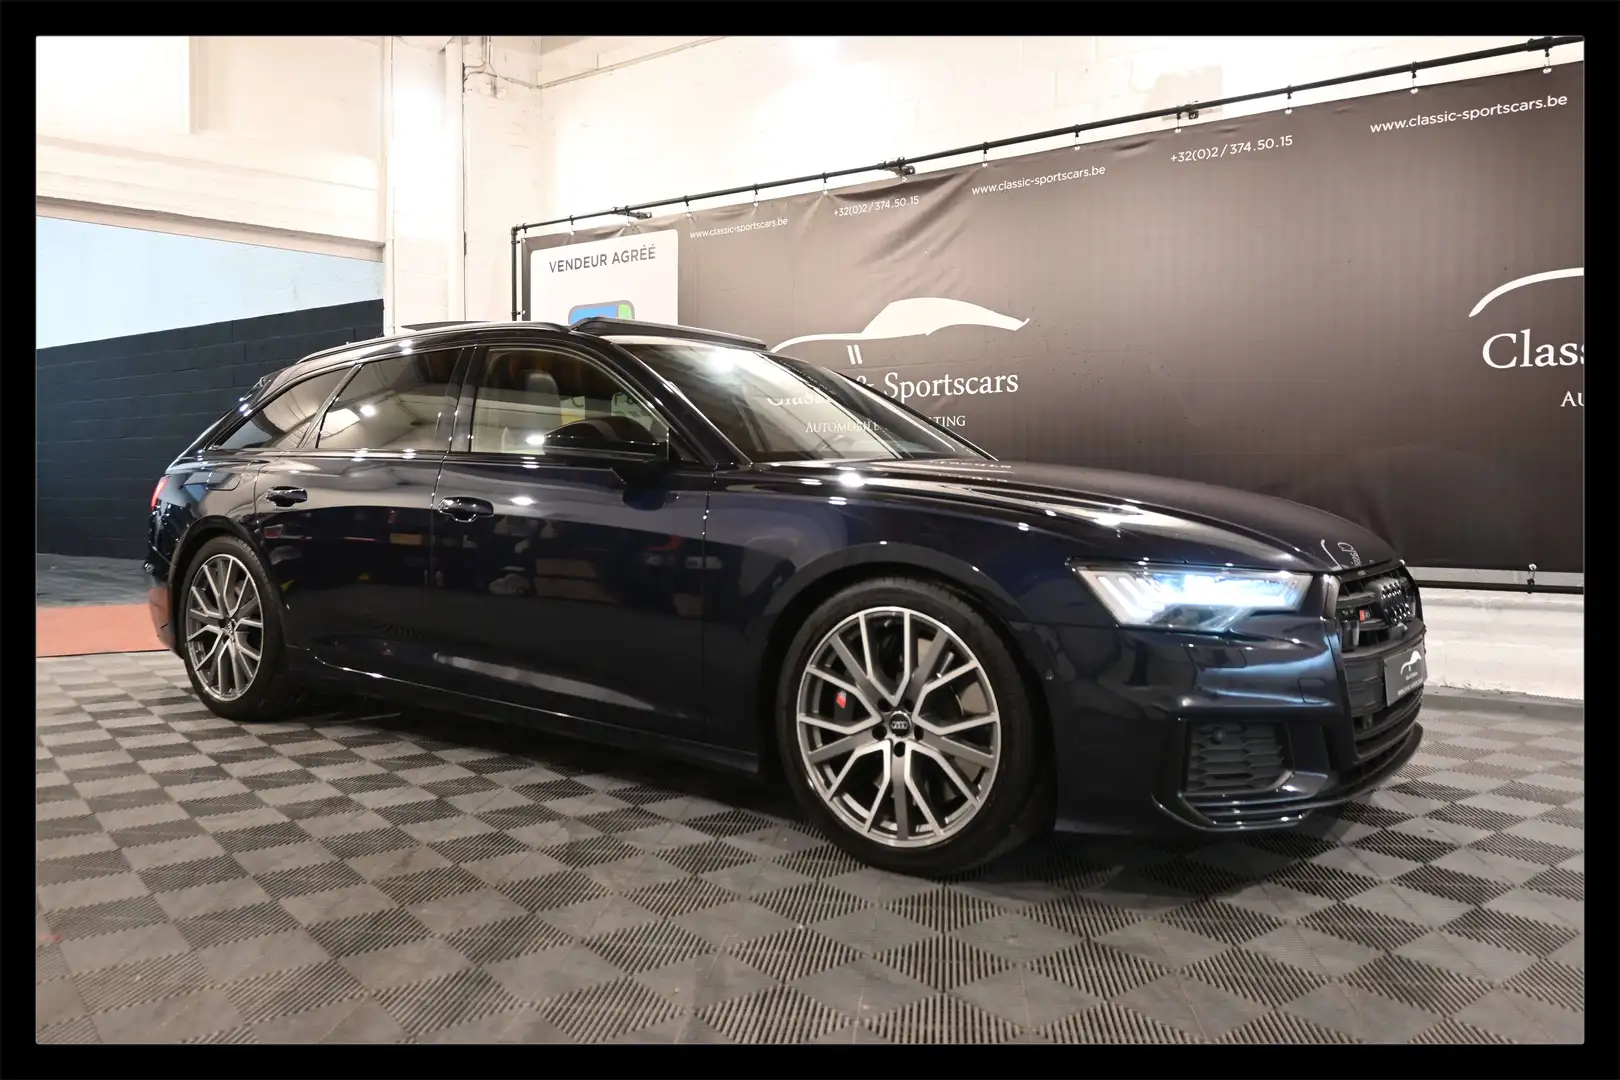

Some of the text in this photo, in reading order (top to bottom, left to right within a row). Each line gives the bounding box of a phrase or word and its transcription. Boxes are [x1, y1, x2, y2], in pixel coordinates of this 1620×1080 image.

[1370, 94, 1568, 133] www.classic-sportscars.be
[971, 165, 1106, 195] www.classic-sportscars.be
[690, 217, 788, 239] www.classic-sportscars.be
[549, 244, 656, 273] VENDEUR AGRÉÉ
[884, 372, 1019, 403] Sportscars
